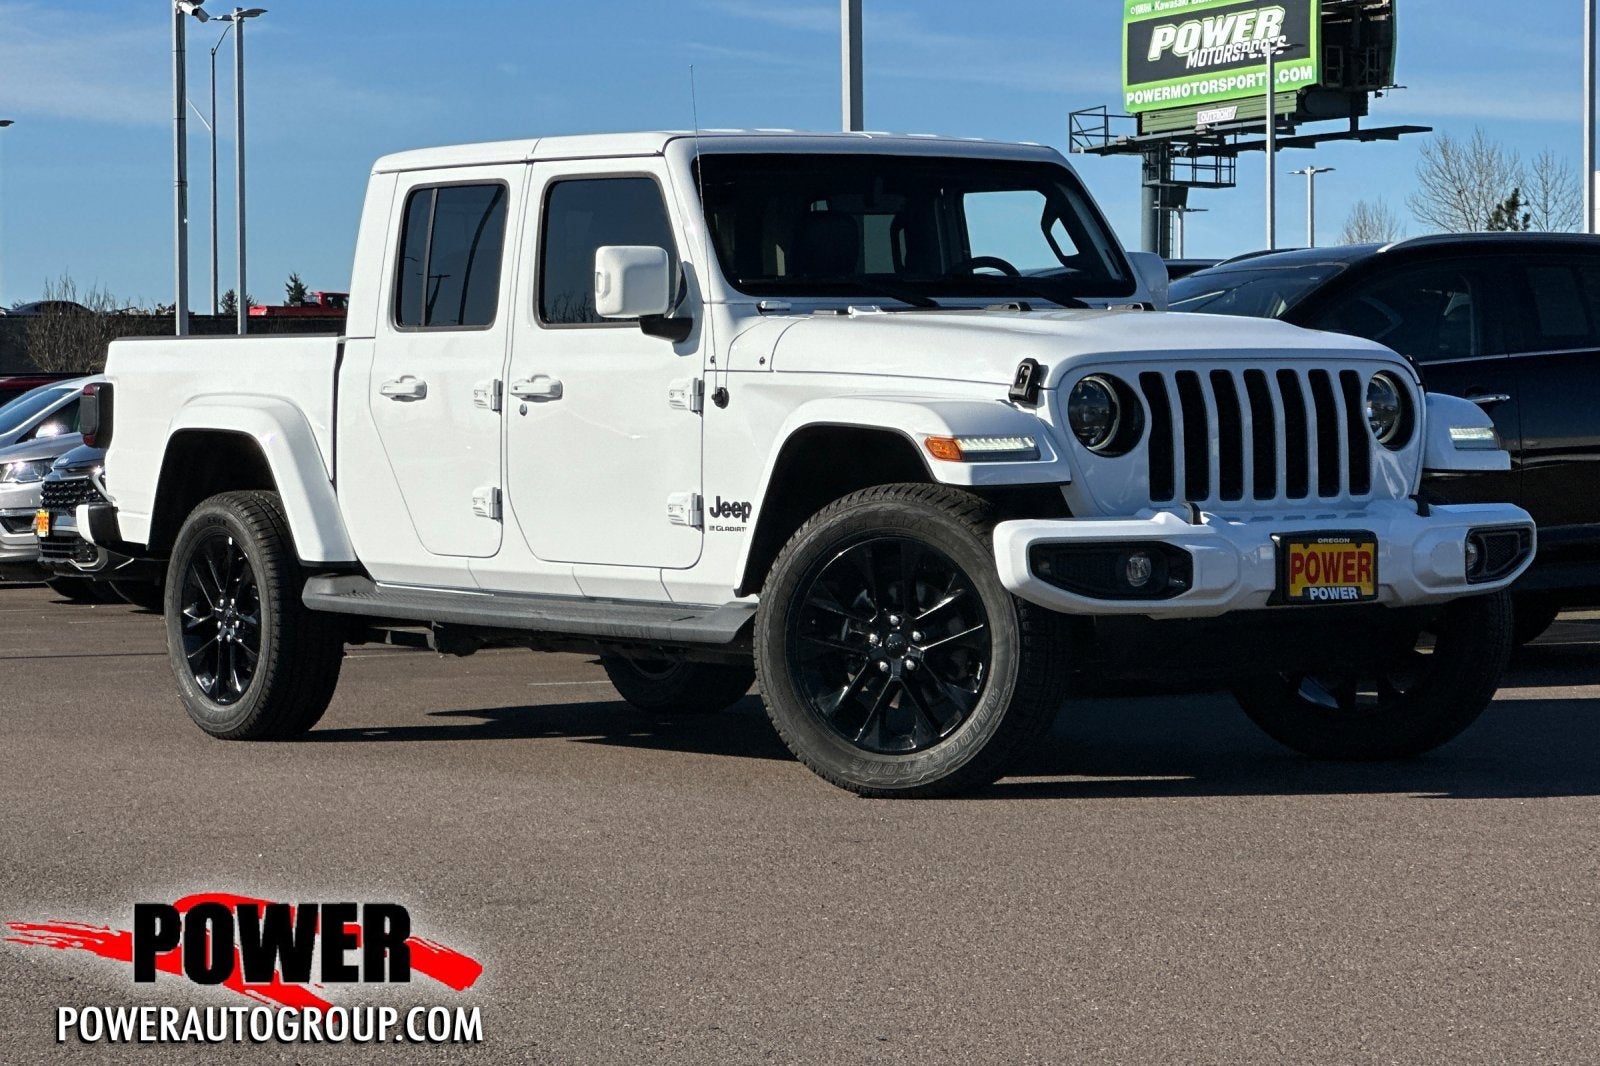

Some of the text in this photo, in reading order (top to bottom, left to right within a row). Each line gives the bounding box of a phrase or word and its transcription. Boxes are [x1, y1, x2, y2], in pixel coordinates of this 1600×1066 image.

[1148, 5, 1286, 62] POWER
[1126, 65, 1313, 106] POWERMOTORSPORT.COM
[709, 495, 752, 523] Jeep
[1290, 551, 1372, 585] POWER
[1308, 586, 1358, 601] POWER
